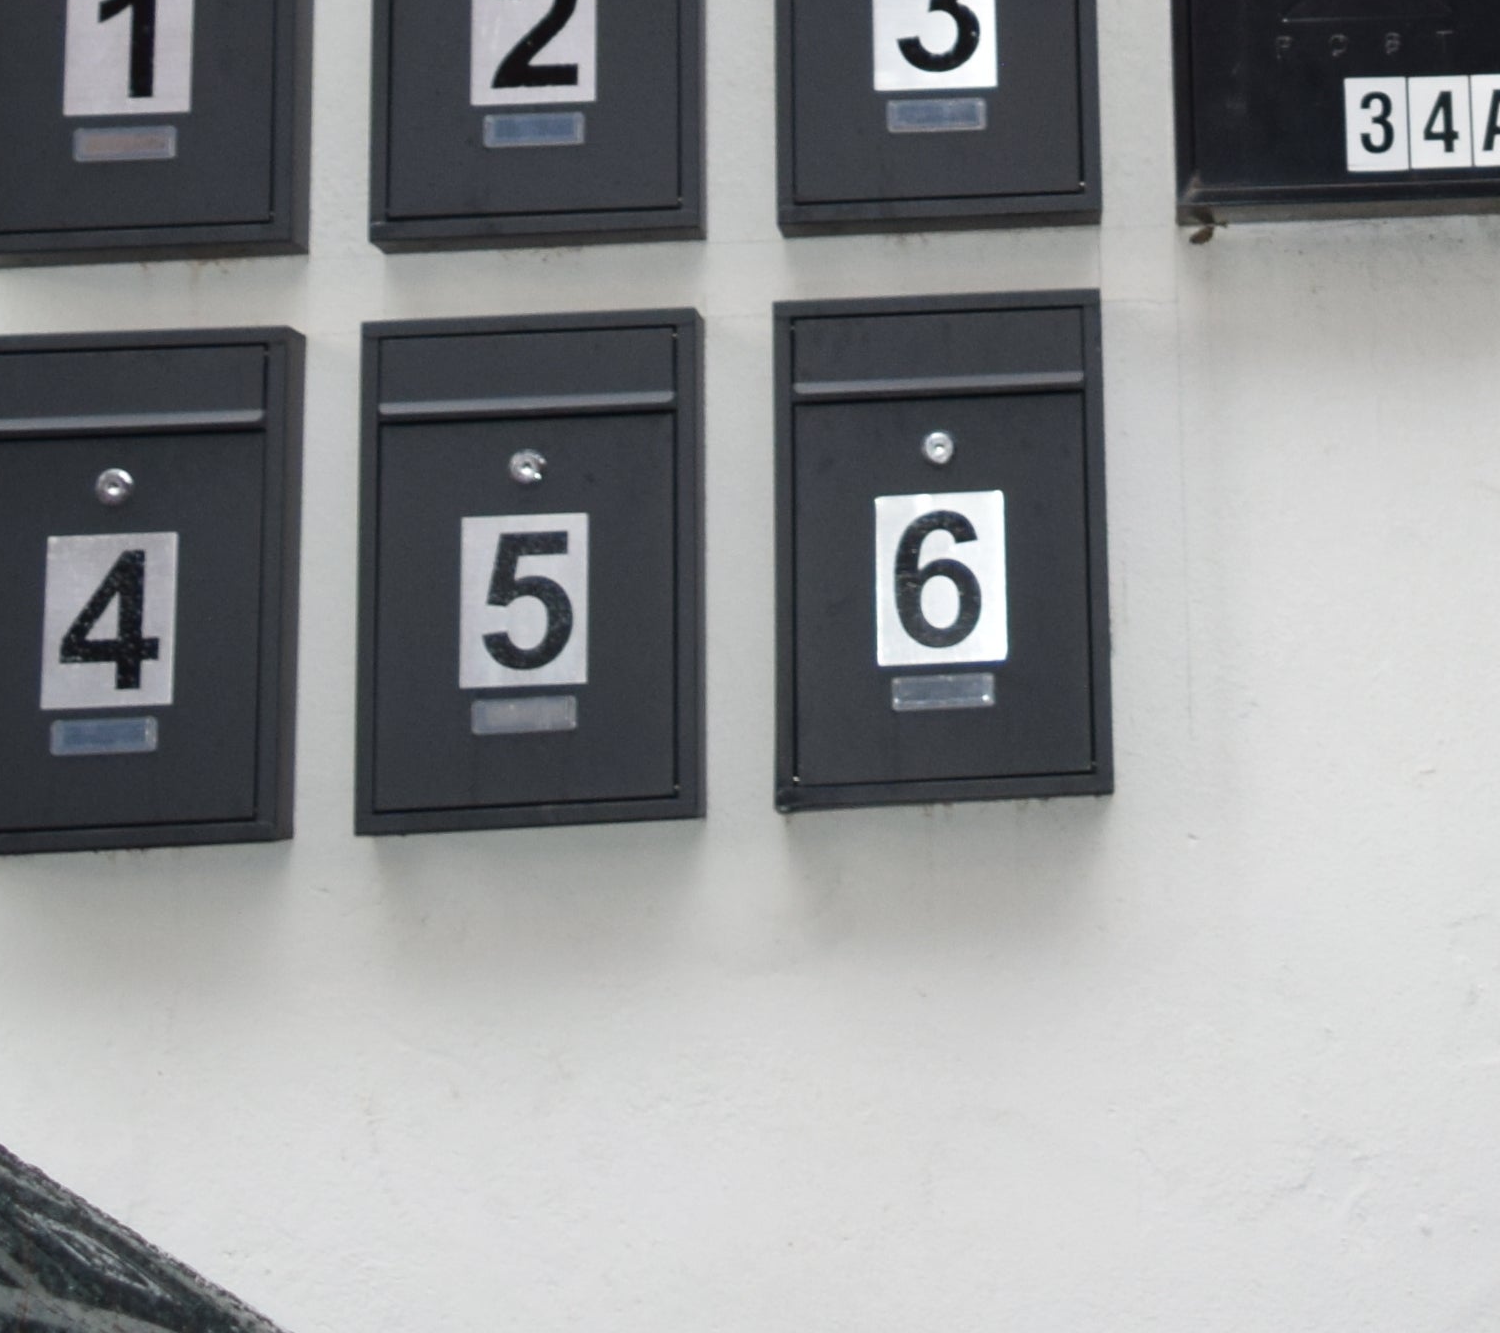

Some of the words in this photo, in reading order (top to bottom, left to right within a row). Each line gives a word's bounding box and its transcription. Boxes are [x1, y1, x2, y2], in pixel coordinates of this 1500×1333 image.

[58, 548, 161, 691] 4
[480, 530, 574, 671] 5
[893, 509, 982, 650] 6
